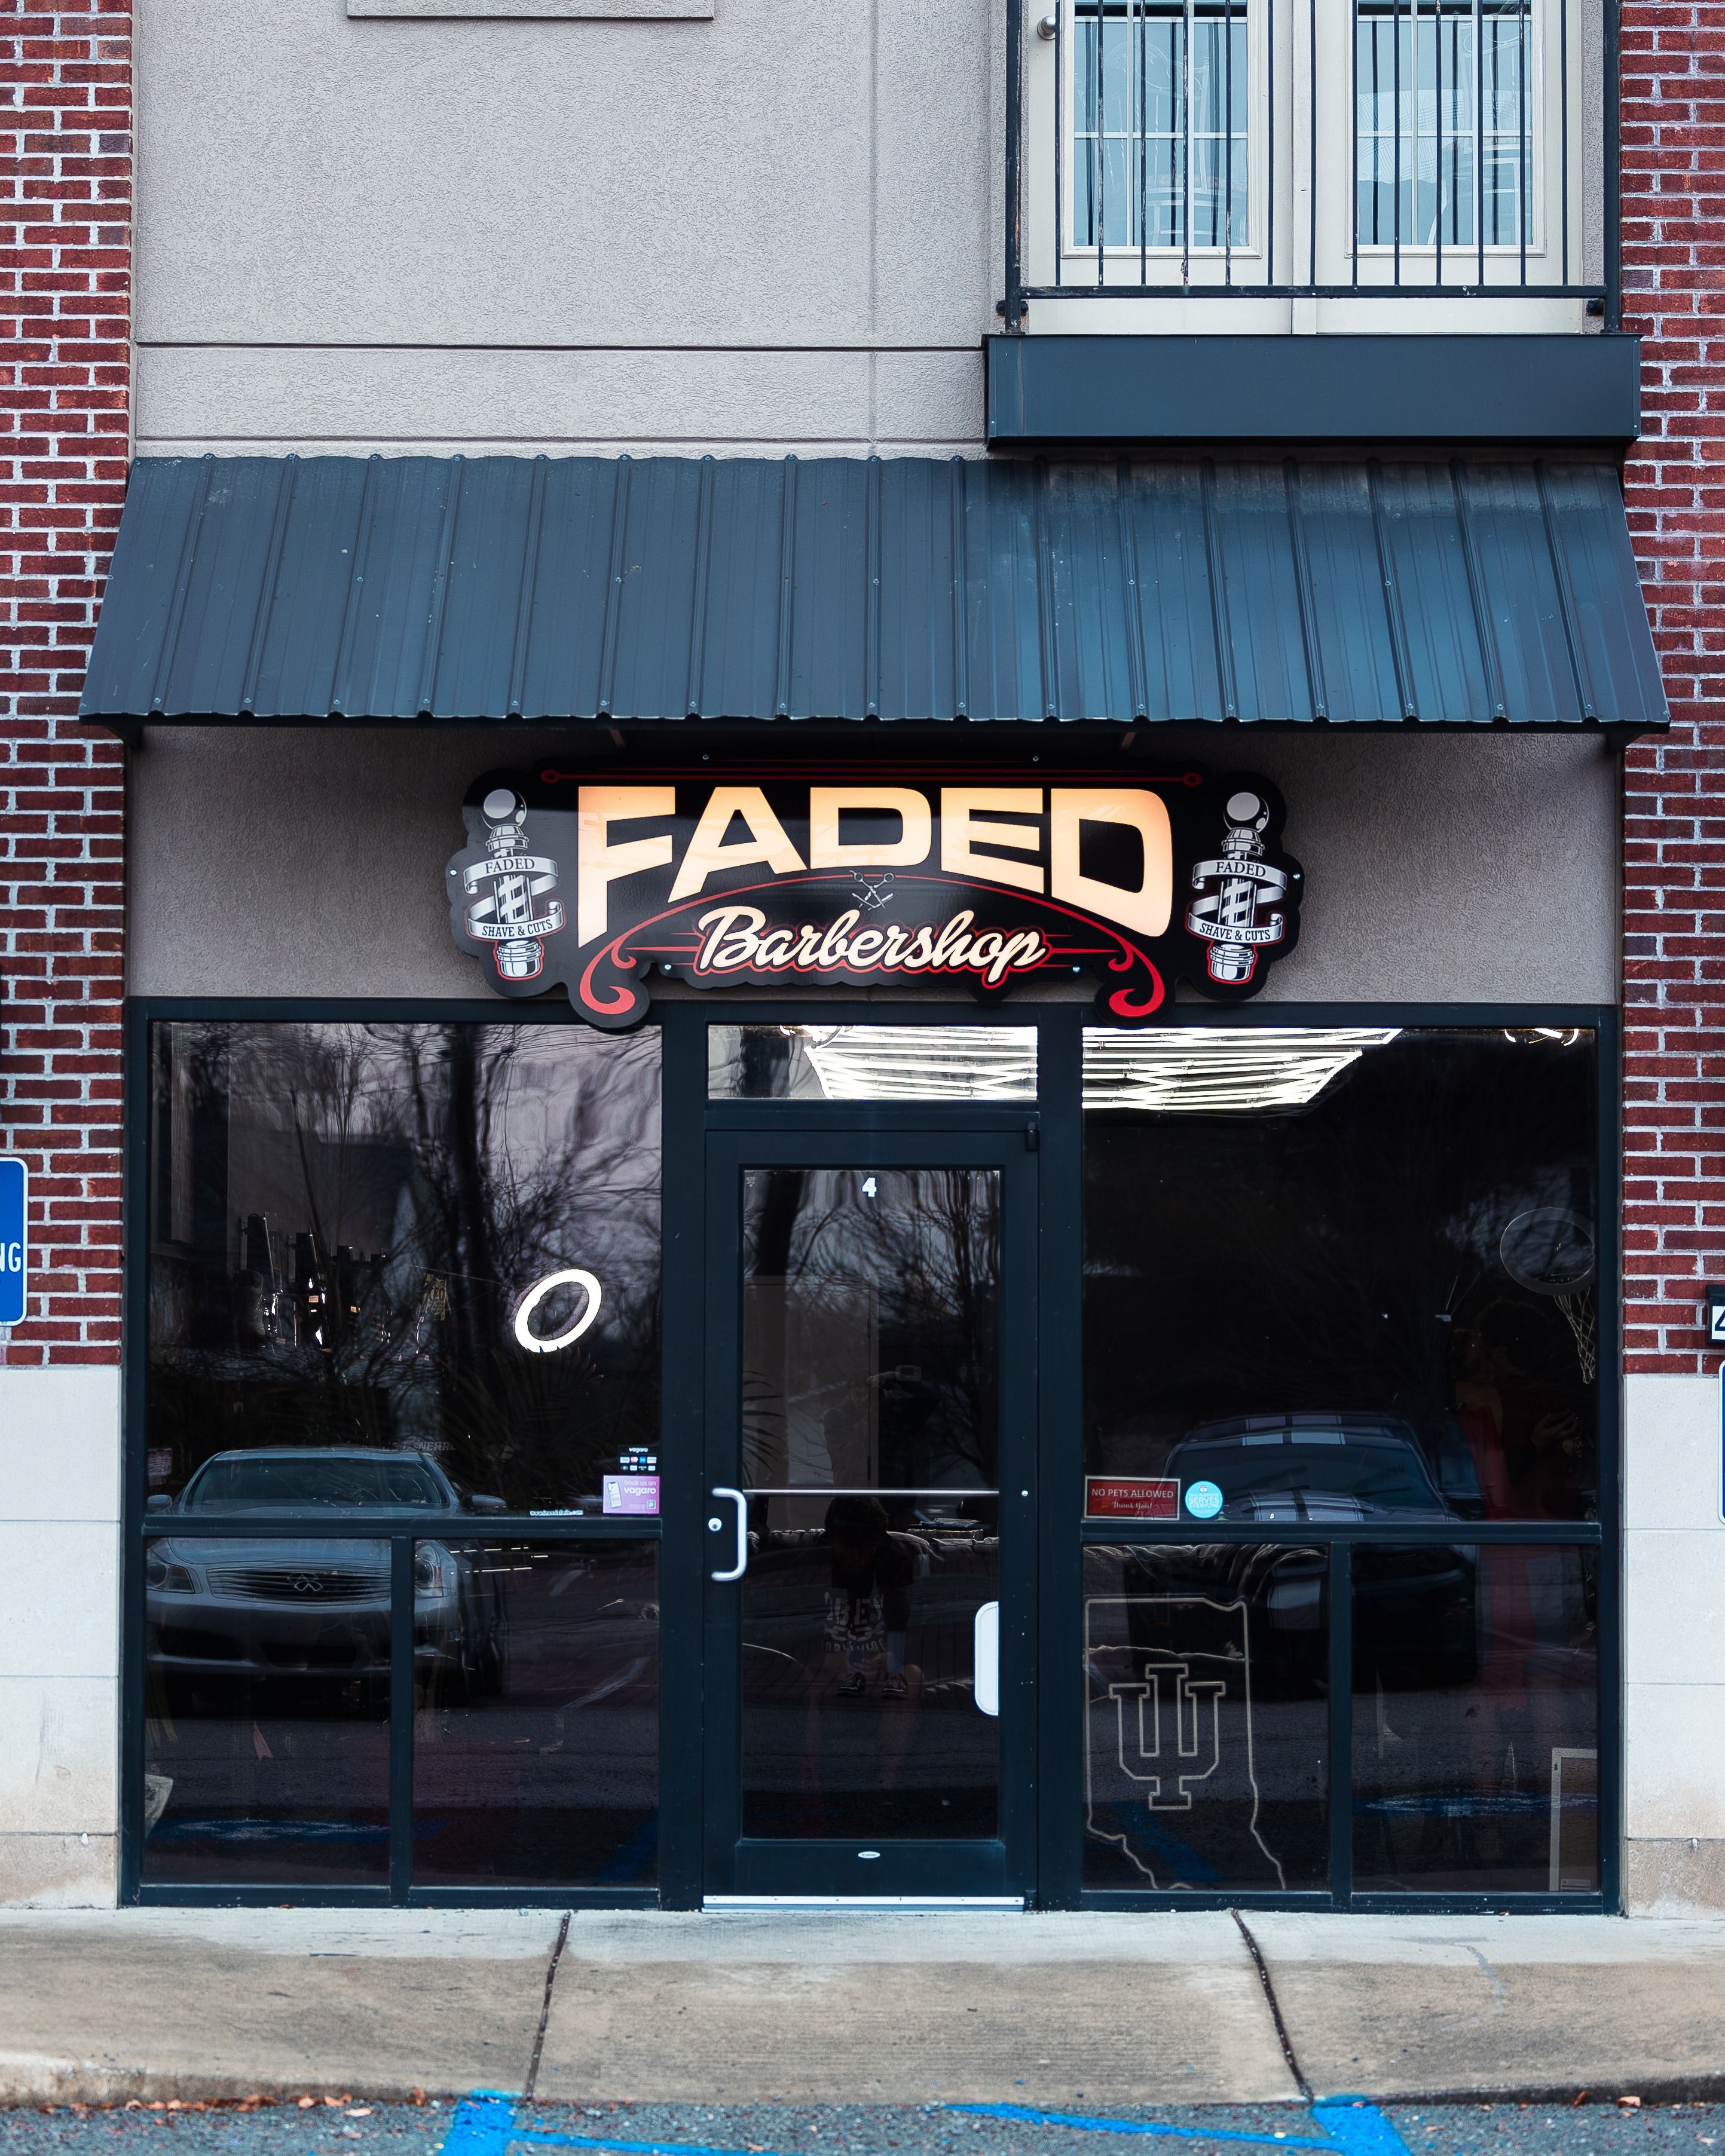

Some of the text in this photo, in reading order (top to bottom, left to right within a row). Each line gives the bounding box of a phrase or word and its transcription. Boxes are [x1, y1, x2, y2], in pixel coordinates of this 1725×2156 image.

[485, 858, 535, 874] FADED
[578, 786, 1173, 948] FADED
[1215, 862, 1267, 877] FADED
[482, 919, 553, 937] SHAVE & CUTS
[1199, 923, 1271, 941] SHAVE & CUTS
[698, 905, 1046, 983] Barbershop
[861, 1177, 877, 1198] 4
[624, 1487, 657, 1496] vagaro
[1091, 1488, 1174, 1499] NO PETS ALLOWED
